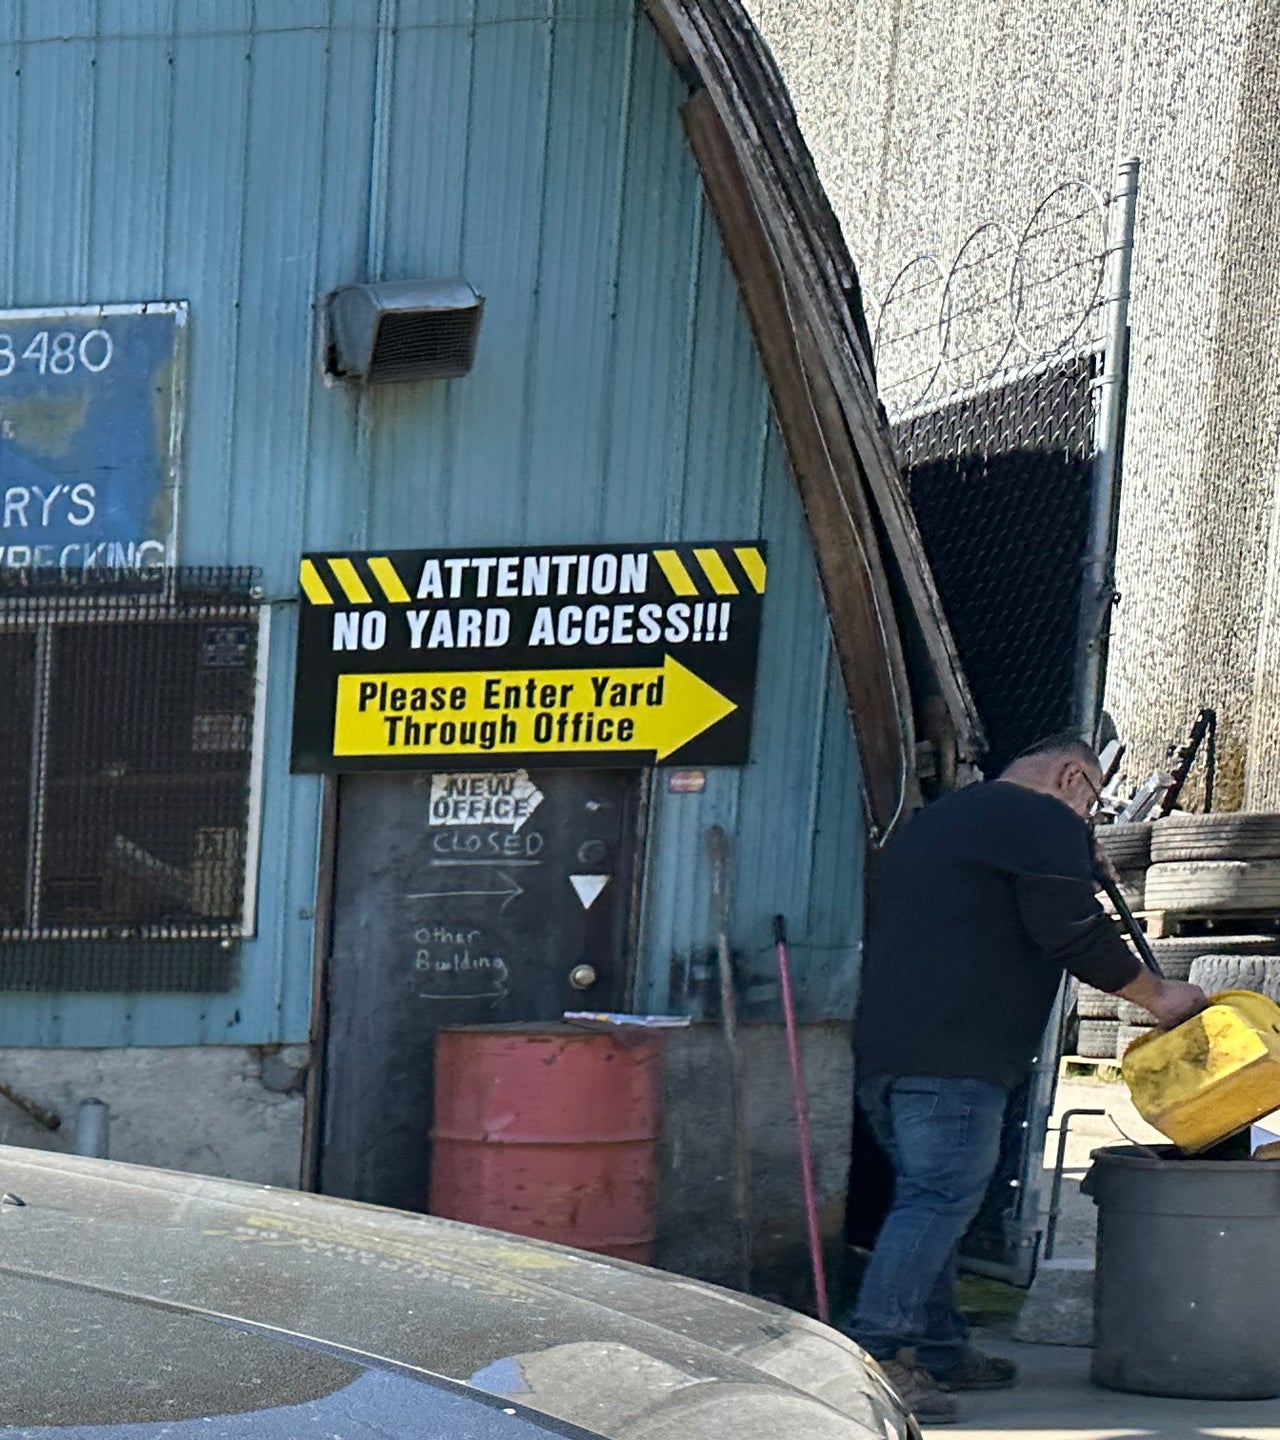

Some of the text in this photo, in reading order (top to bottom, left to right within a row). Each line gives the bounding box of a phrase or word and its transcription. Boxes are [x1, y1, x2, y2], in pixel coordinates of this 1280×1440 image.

[416, 553, 649, 600] ATTENTION
[332, 602, 732, 651] NO YARD ACCESS!!!
[358, 674, 665, 712] Please Enter Yard
[383, 708, 635, 750] Through Office
[446, 776, 514, 797] NEW
[432, 798, 530, 819] OFFICE
[433, 832, 544, 855] CLOSED
[415, 927, 481, 946] Other
[415, 949, 510, 982] Building
